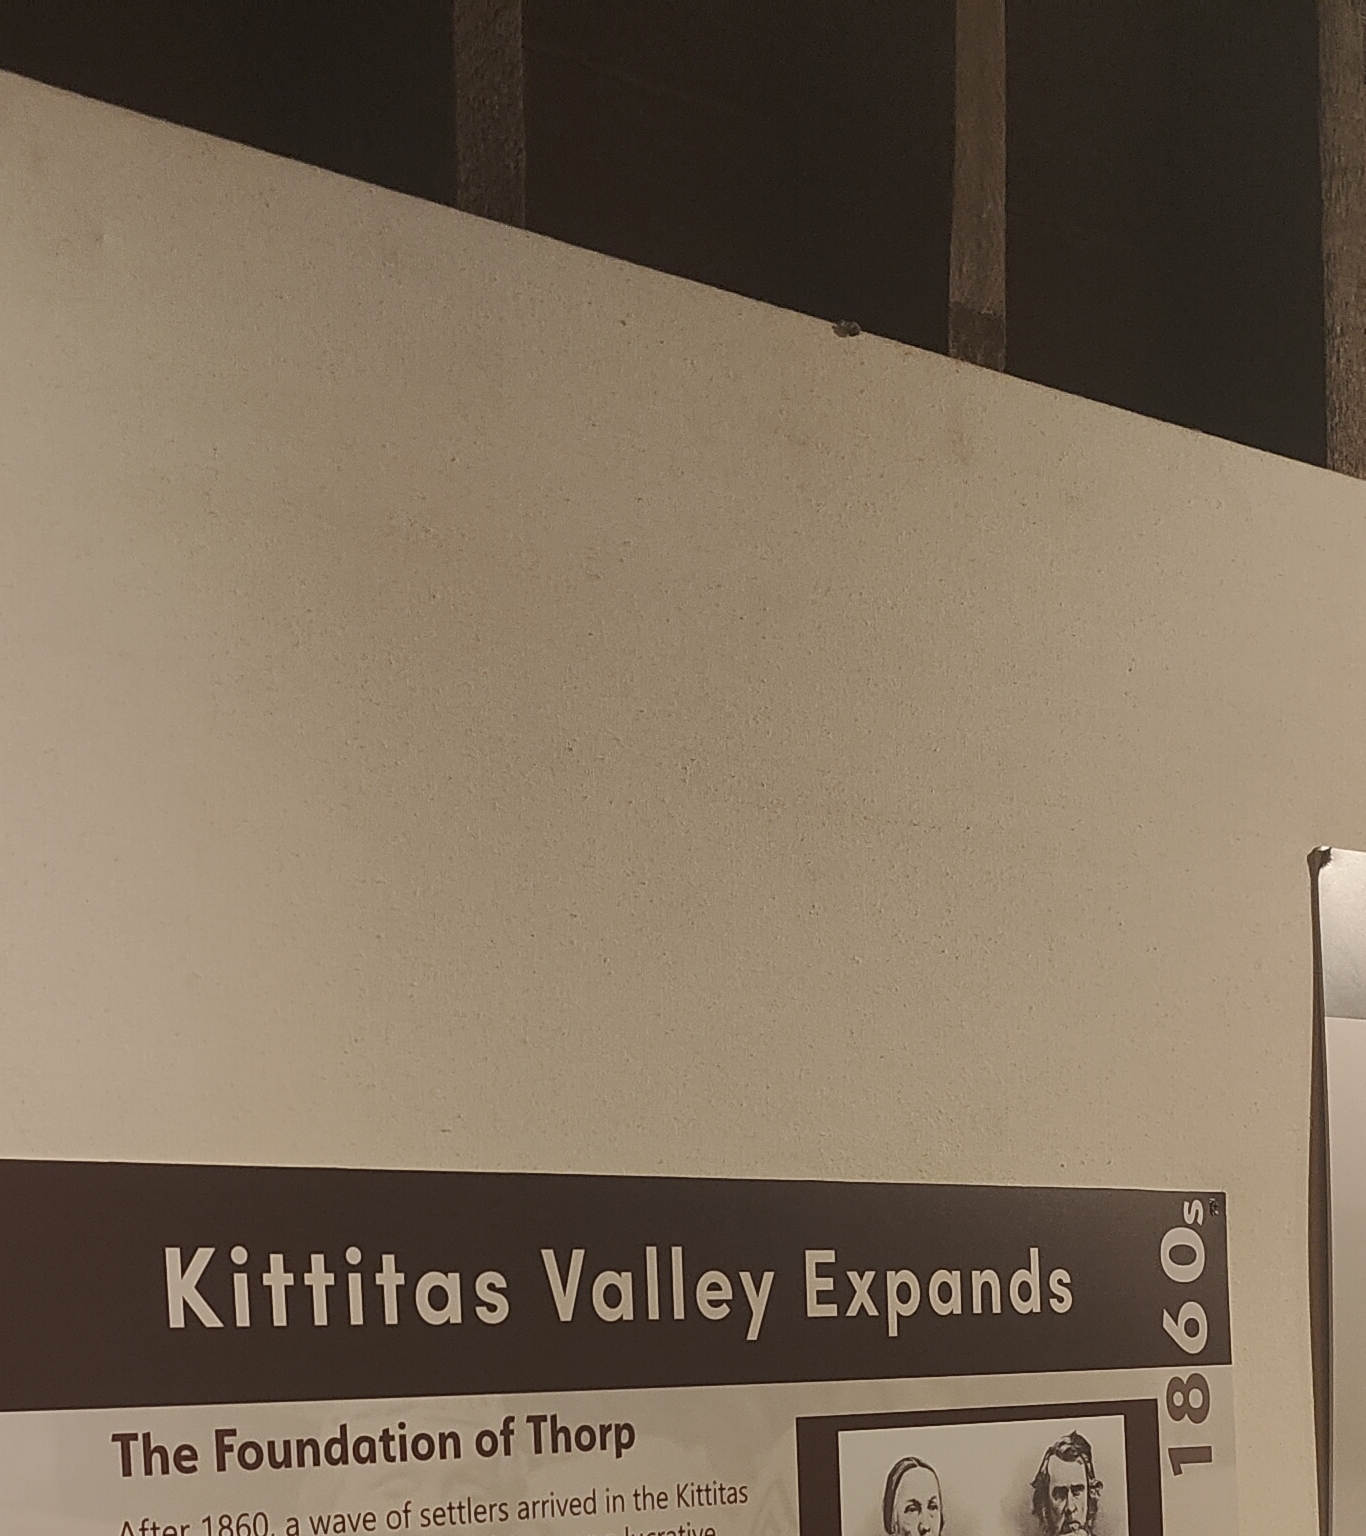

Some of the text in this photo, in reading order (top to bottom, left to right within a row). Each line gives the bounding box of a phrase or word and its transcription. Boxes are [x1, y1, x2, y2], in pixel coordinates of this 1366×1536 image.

[163, 1244, 1073, 1341] Kittitas Valley Expands
[1160, 1198, 1214, 1477] 1860s
[110, 1412, 636, 1478] The Foundation of Thorp
[307, 1510, 377, 1536] wave
[385, 1499, 412, 1530] of
[419, 1495, 509, 1528] settlers
[516, 1486, 597, 1521] arrived
[604, 1486, 625, 1514] in
[631, 1483, 669, 1512] the
[675, 1478, 749, 1509] Kittitas
